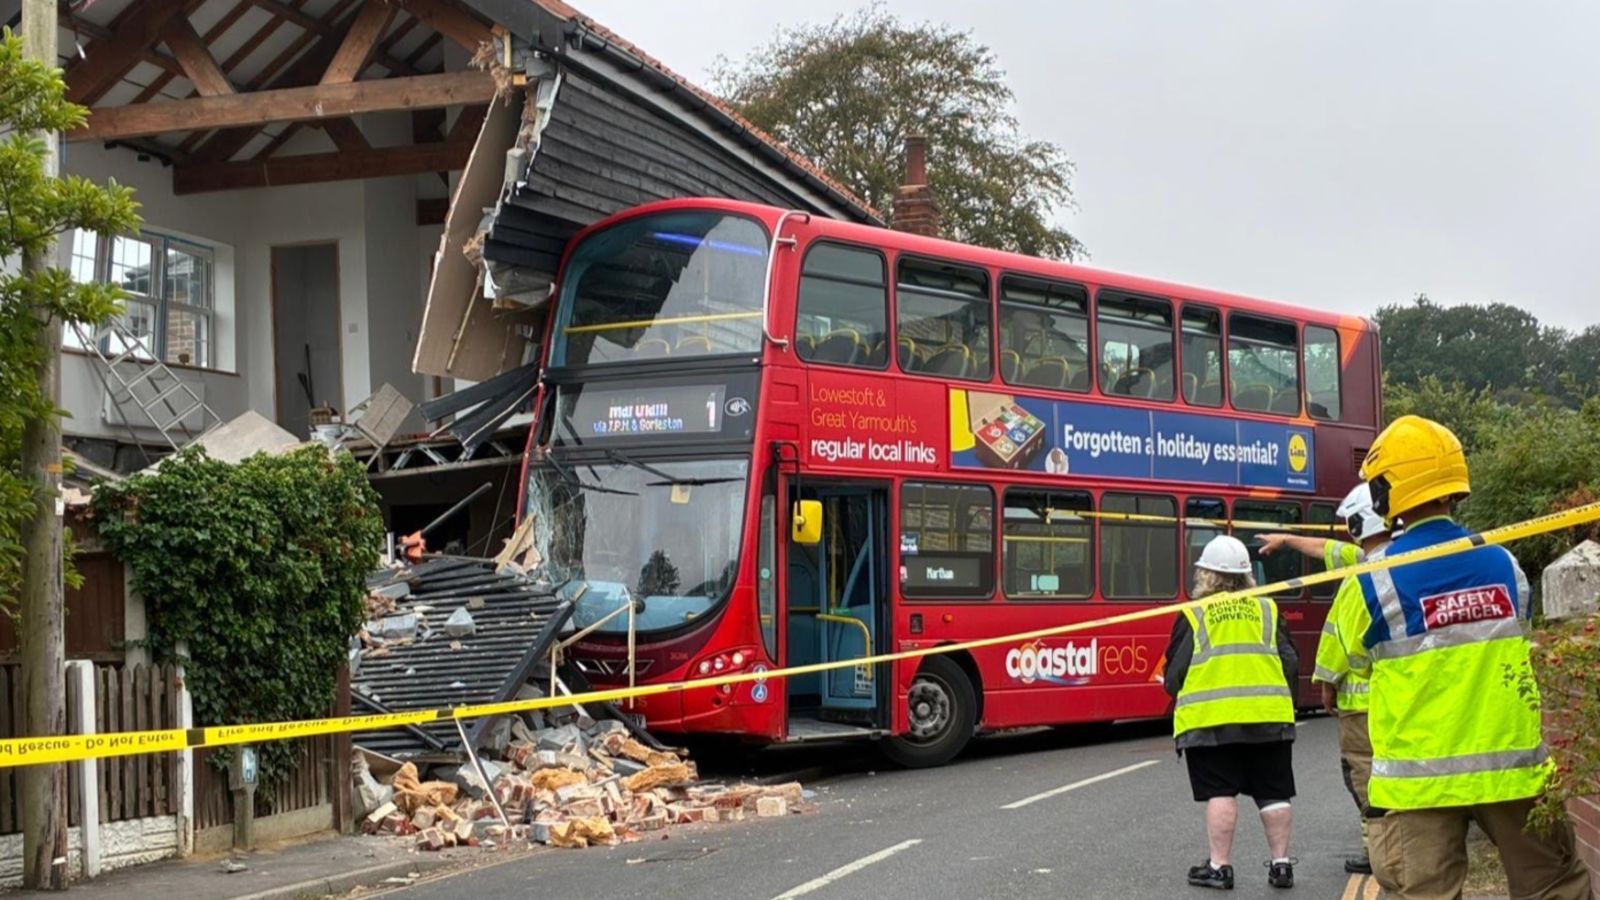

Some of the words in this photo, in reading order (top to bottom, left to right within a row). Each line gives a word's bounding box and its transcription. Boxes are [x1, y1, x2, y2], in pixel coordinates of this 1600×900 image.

[811, 383, 874, 406] Lowestoft
[876, 389, 887, 408] &
[706, 401, 717, 429] 1
[811, 407, 846, 429] Great
[848, 411, 918, 434] Yarmouth's
[811, 436, 867, 462] regular
[868, 437, 902, 462] local
[904, 441, 936, 464] links
[1064, 424, 1142, 458] Forgotten
[1145, 436, 1154, 456] a
[1157, 432, 1212, 466] holiday
[1213, 440, 1279, 466] essential?
[1207, 597, 1257, 610] BUILDING
[1209, 604, 1256, 617] CONTROL
[1435, 589, 1497, 612] SAFETY
[1208, 612, 1260, 625] SURVEYOR
[1436, 604, 1504, 625] OFFICER
[1005, 637, 1098, 678] coastal
